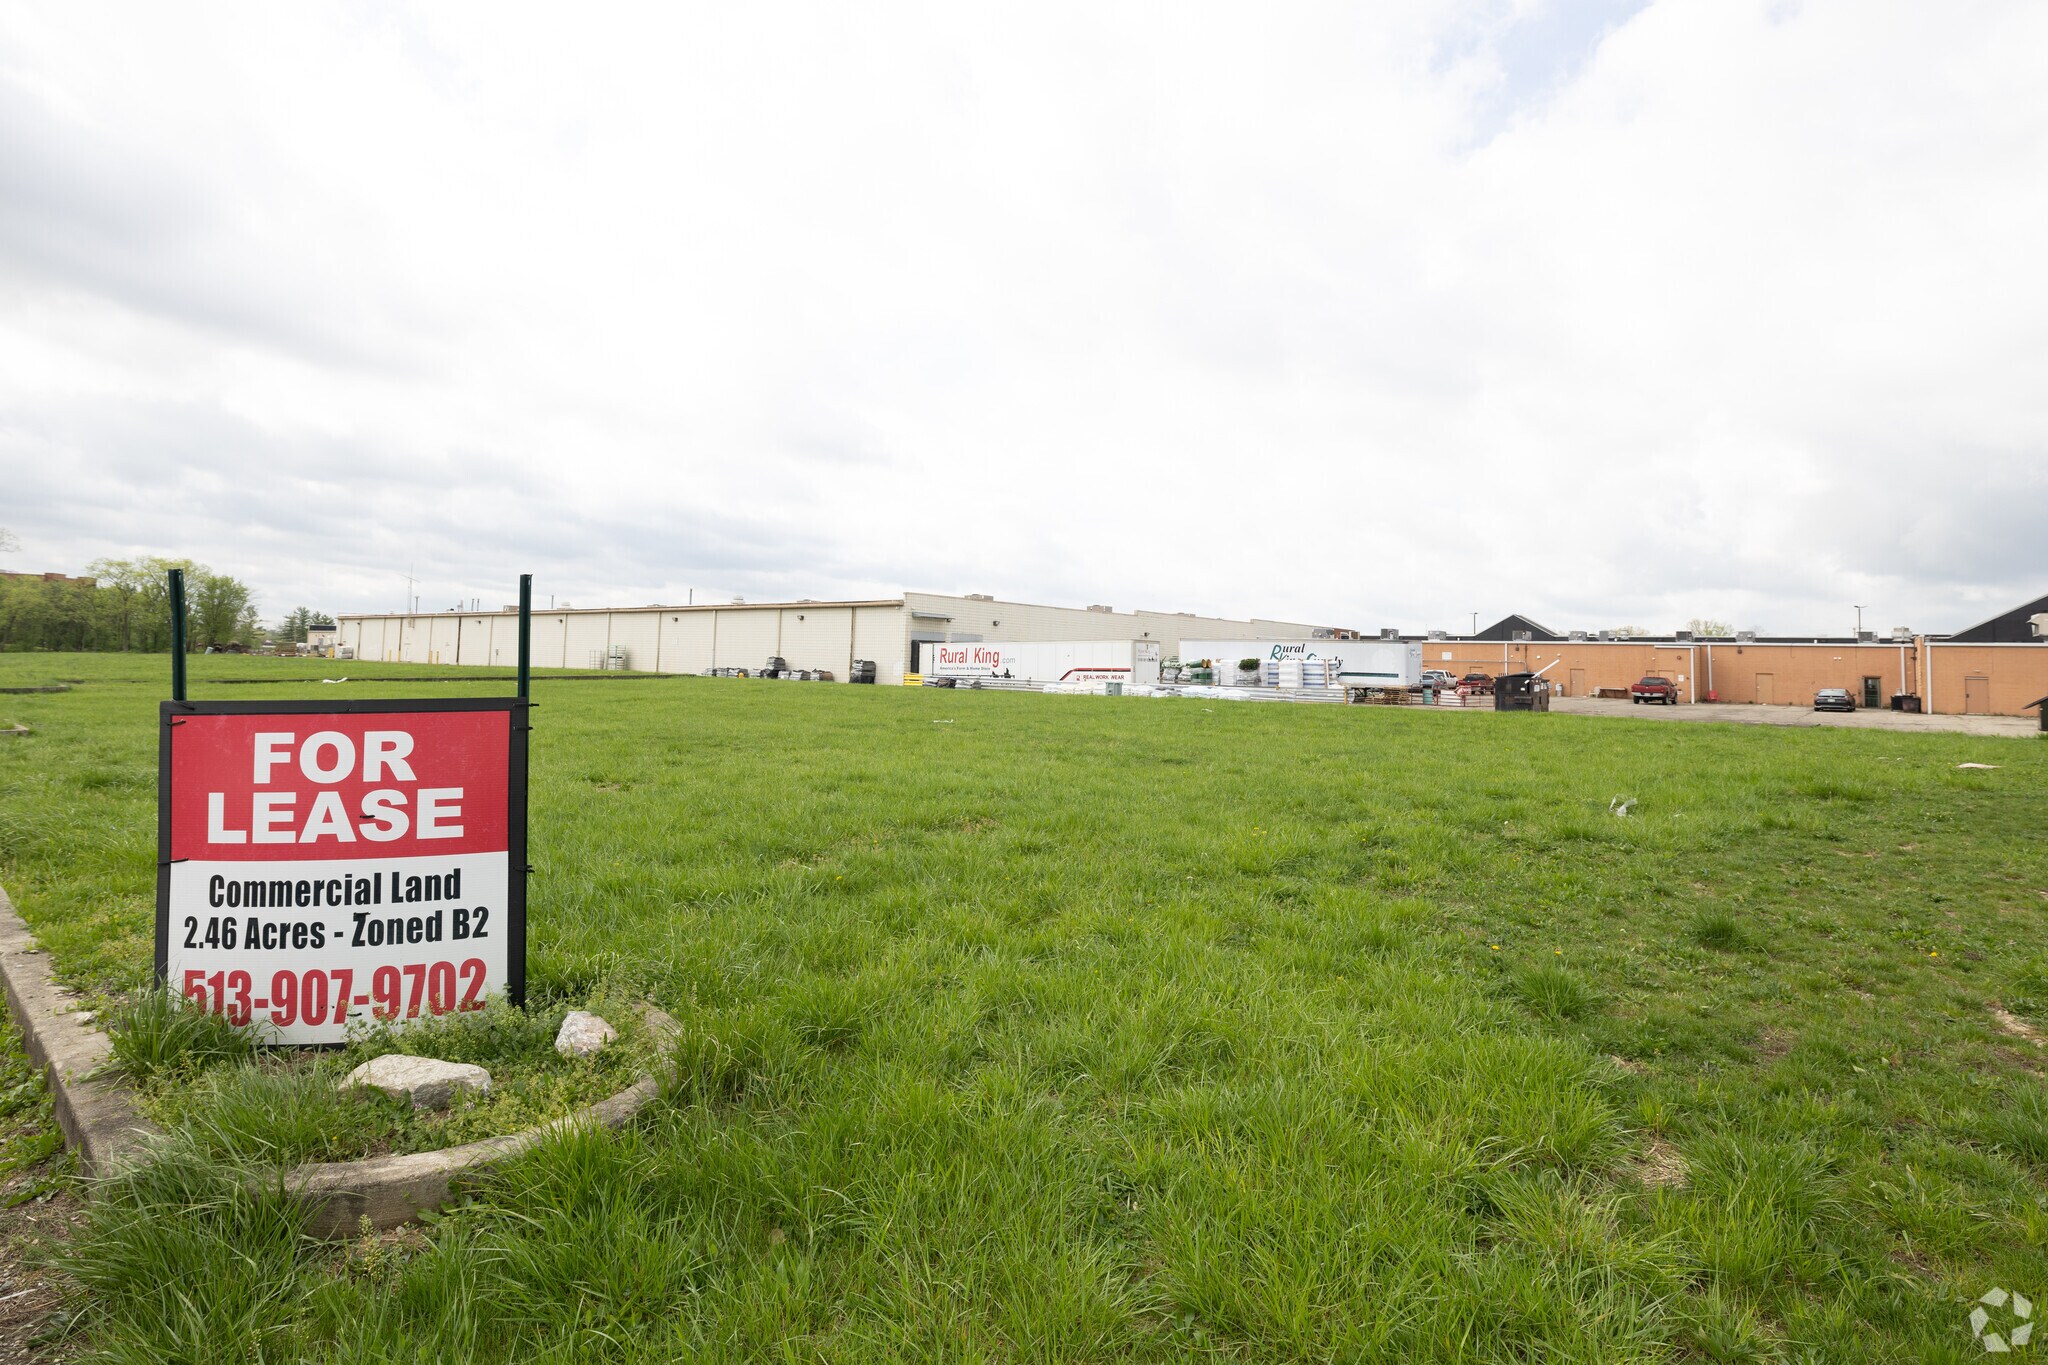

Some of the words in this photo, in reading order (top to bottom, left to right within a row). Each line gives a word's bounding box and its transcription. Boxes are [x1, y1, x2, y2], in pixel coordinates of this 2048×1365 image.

[940, 648, 968, 663] Rural
[1270, 643, 1305, 660] Rural
[253, 730, 417, 784] FOR
[207, 787, 465, 844] LEASE
[208, 872, 382, 908] Commercial
[391, 868, 461, 903] Land
[183, 915, 237, 949] 2.46
[244, 916, 326, 950] Acres
[351, 910, 443, 947] Zoned
[452, 906, 489, 940] B2
[184, 958, 488, 1027] 513-907-9702
